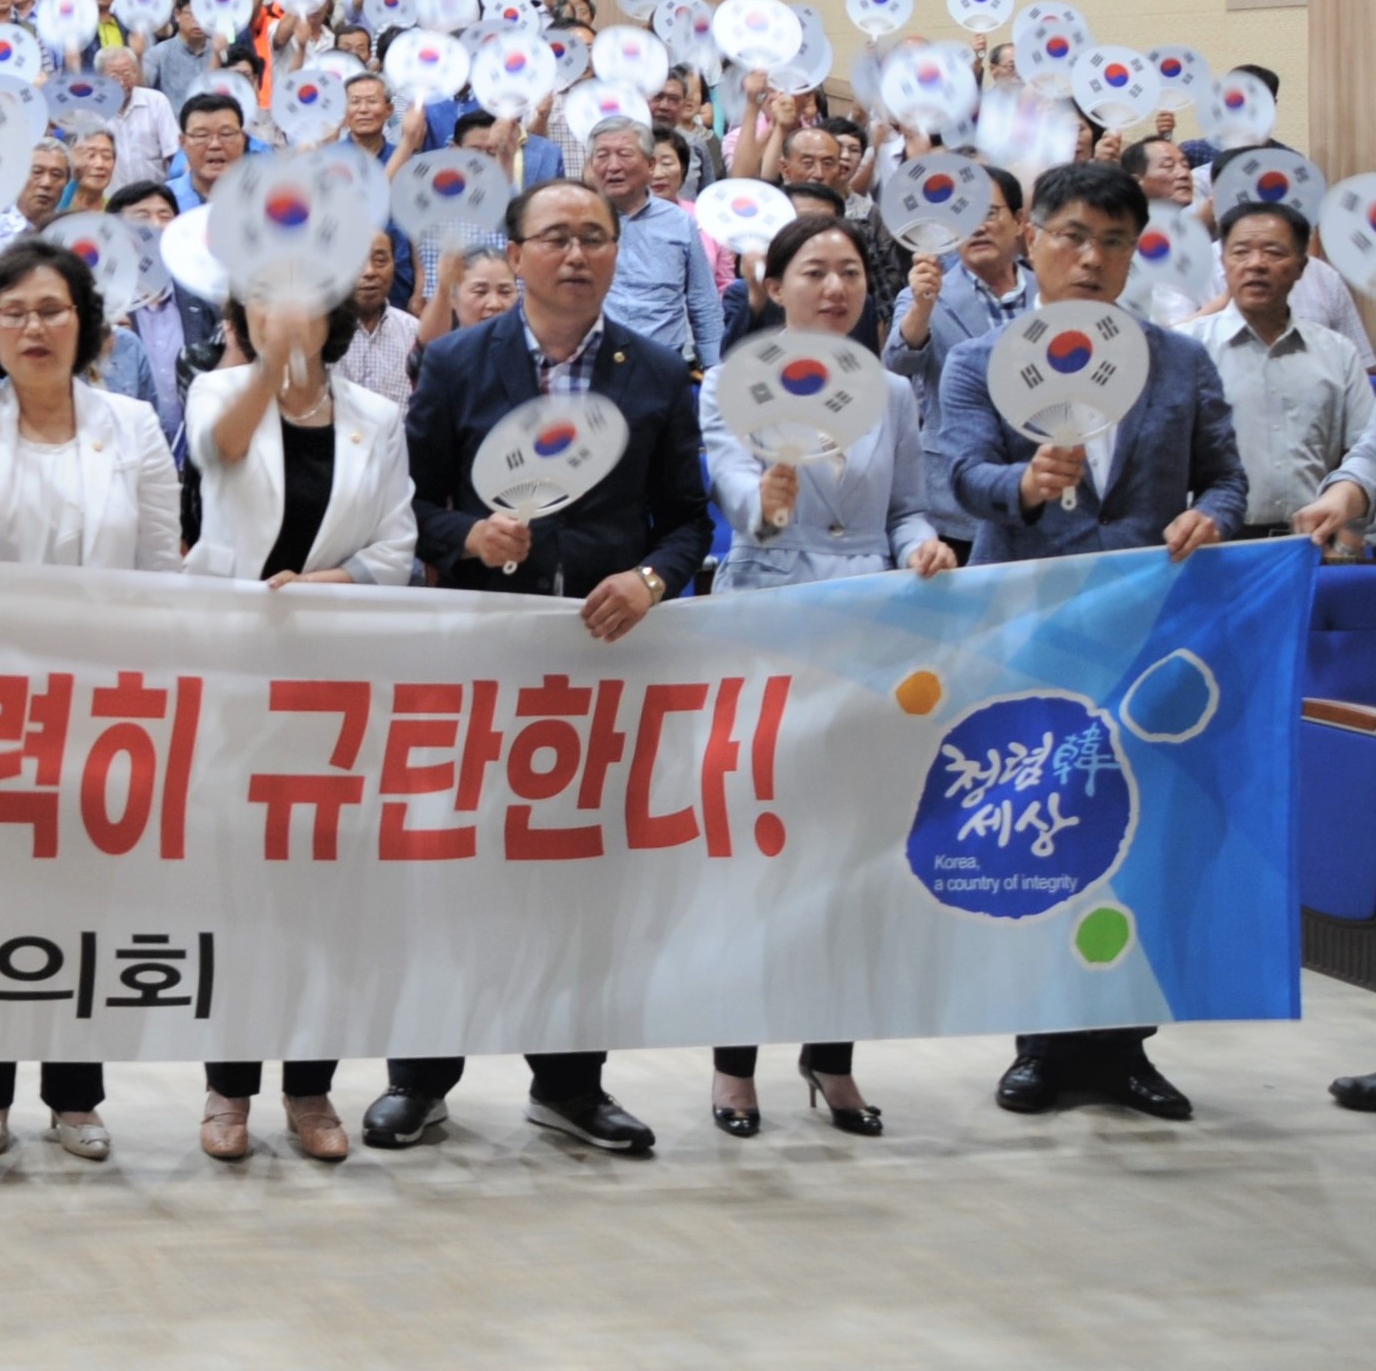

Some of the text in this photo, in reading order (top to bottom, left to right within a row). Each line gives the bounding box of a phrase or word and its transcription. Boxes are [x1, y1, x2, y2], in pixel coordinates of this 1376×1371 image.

[247, 674, 792, 861] 규탄한다!
[957, 792, 1080, 857] 세상
[934, 854, 981, 871] Korea,
[934, 874, 1078, 894] a country of integrity
